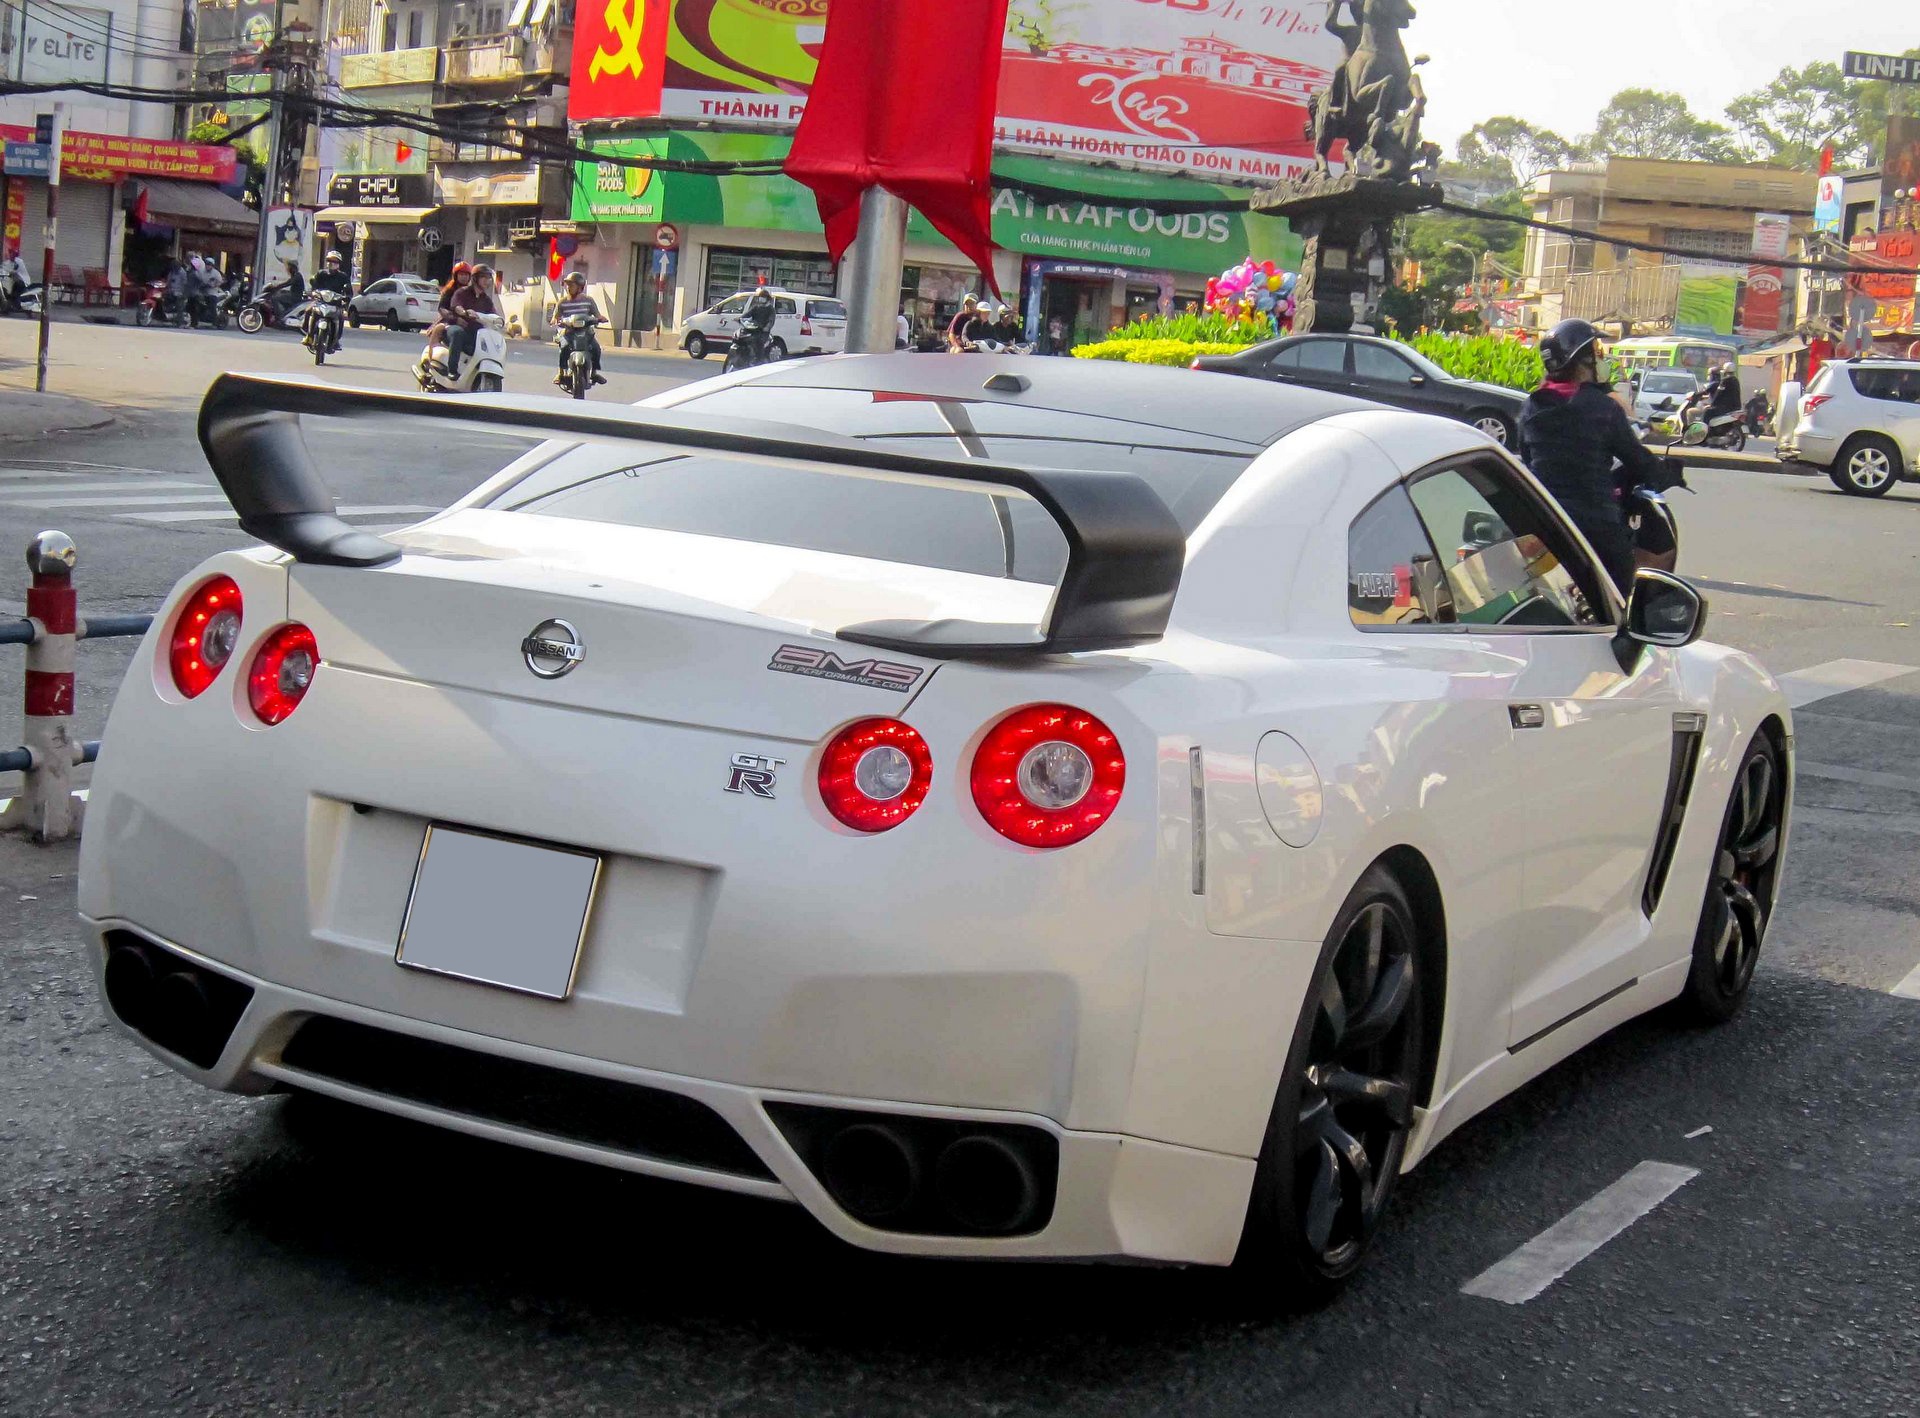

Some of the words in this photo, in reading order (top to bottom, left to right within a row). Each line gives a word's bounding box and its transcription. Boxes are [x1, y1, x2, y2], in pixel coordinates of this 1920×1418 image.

[1854, 54, 1906, 79] LINH
[699, 98, 779, 119] THÀNH
[1016, 127, 1063, 147] HÂN
[1072, 135, 1126, 156] HOAN
[1193, 151, 1232, 171] ĐÓN
[359, 178, 397, 193] CHIPU
[596, 178, 625, 192] FOODS
[990, 188, 1230, 243] ATRAFOODS
[524, 639, 576, 657] NISSAN
[770, 661, 793, 672] AMS
